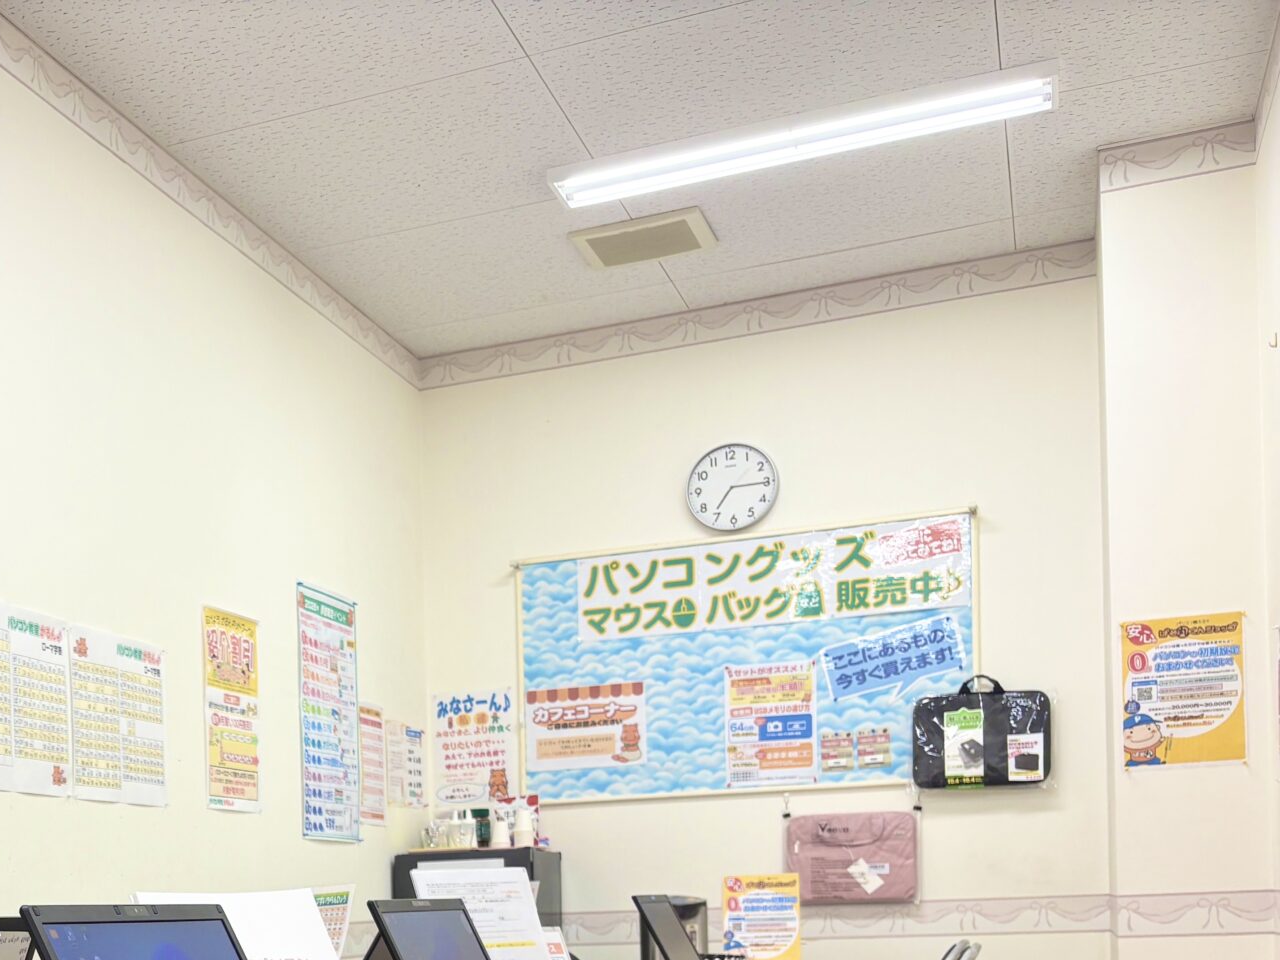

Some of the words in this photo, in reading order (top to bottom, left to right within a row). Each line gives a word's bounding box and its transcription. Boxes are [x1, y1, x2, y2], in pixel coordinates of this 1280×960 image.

[725, 450, 736, 461] 12
[710, 457, 717, 467] 11
[757, 461, 764, 472] 2
[697, 471, 708, 481] 10
[763, 476, 770, 487] 3
[694, 488, 702, 497] 9
[700, 503, 707, 513] 8
[747, 507, 754, 517] 5
[713, 512, 721, 522] 7
[730, 514, 737, 525] 6
[583, 531, 876, 599] パソコングッズ
[582, 601, 673, 635] マウス
[706, 587, 792, 625] バッグ
[533, 701, 638, 725] カフェコーナー
